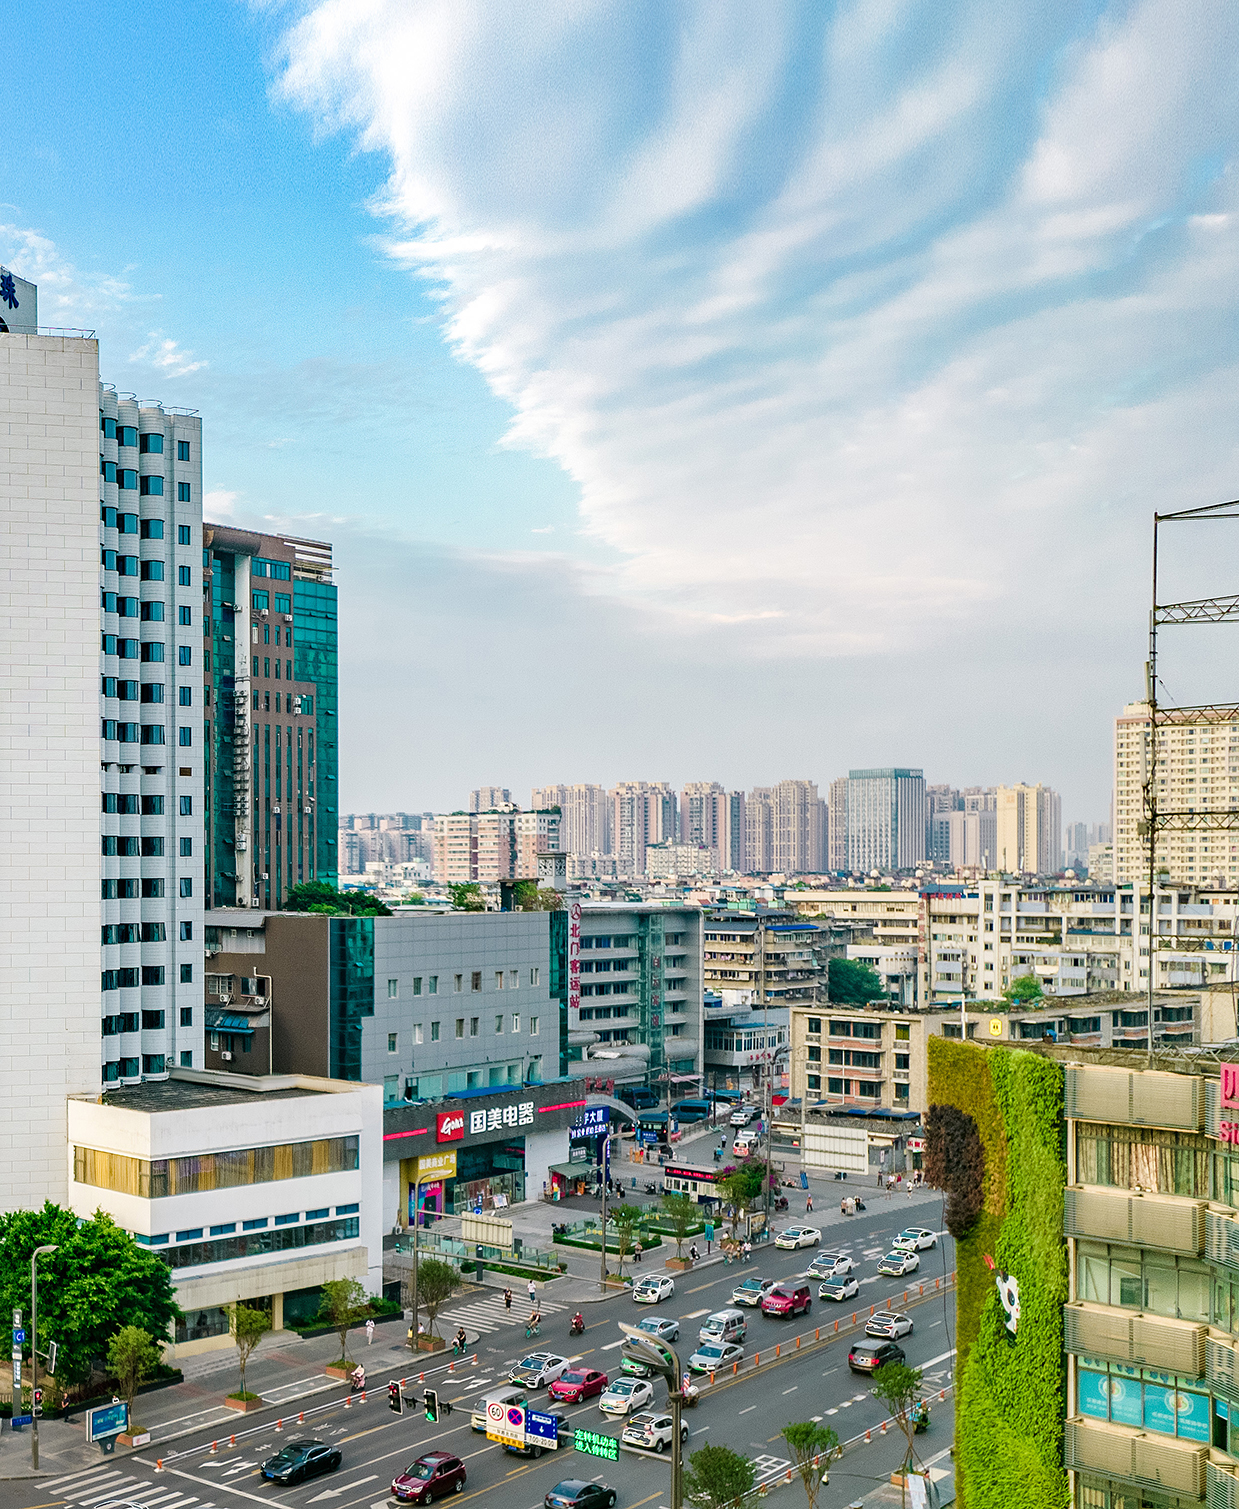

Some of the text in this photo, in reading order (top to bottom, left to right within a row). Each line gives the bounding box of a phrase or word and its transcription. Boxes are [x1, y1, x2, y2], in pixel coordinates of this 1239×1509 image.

[570, 923, 580, 1009] 北门客运站
[470, 1101, 534, 1135] 国美电器
[419, 1154, 456, 1170] 国美商业广场
[491, 1407, 501, 1417] 60
[574, 1429, 618, 1449] 左转机动车
